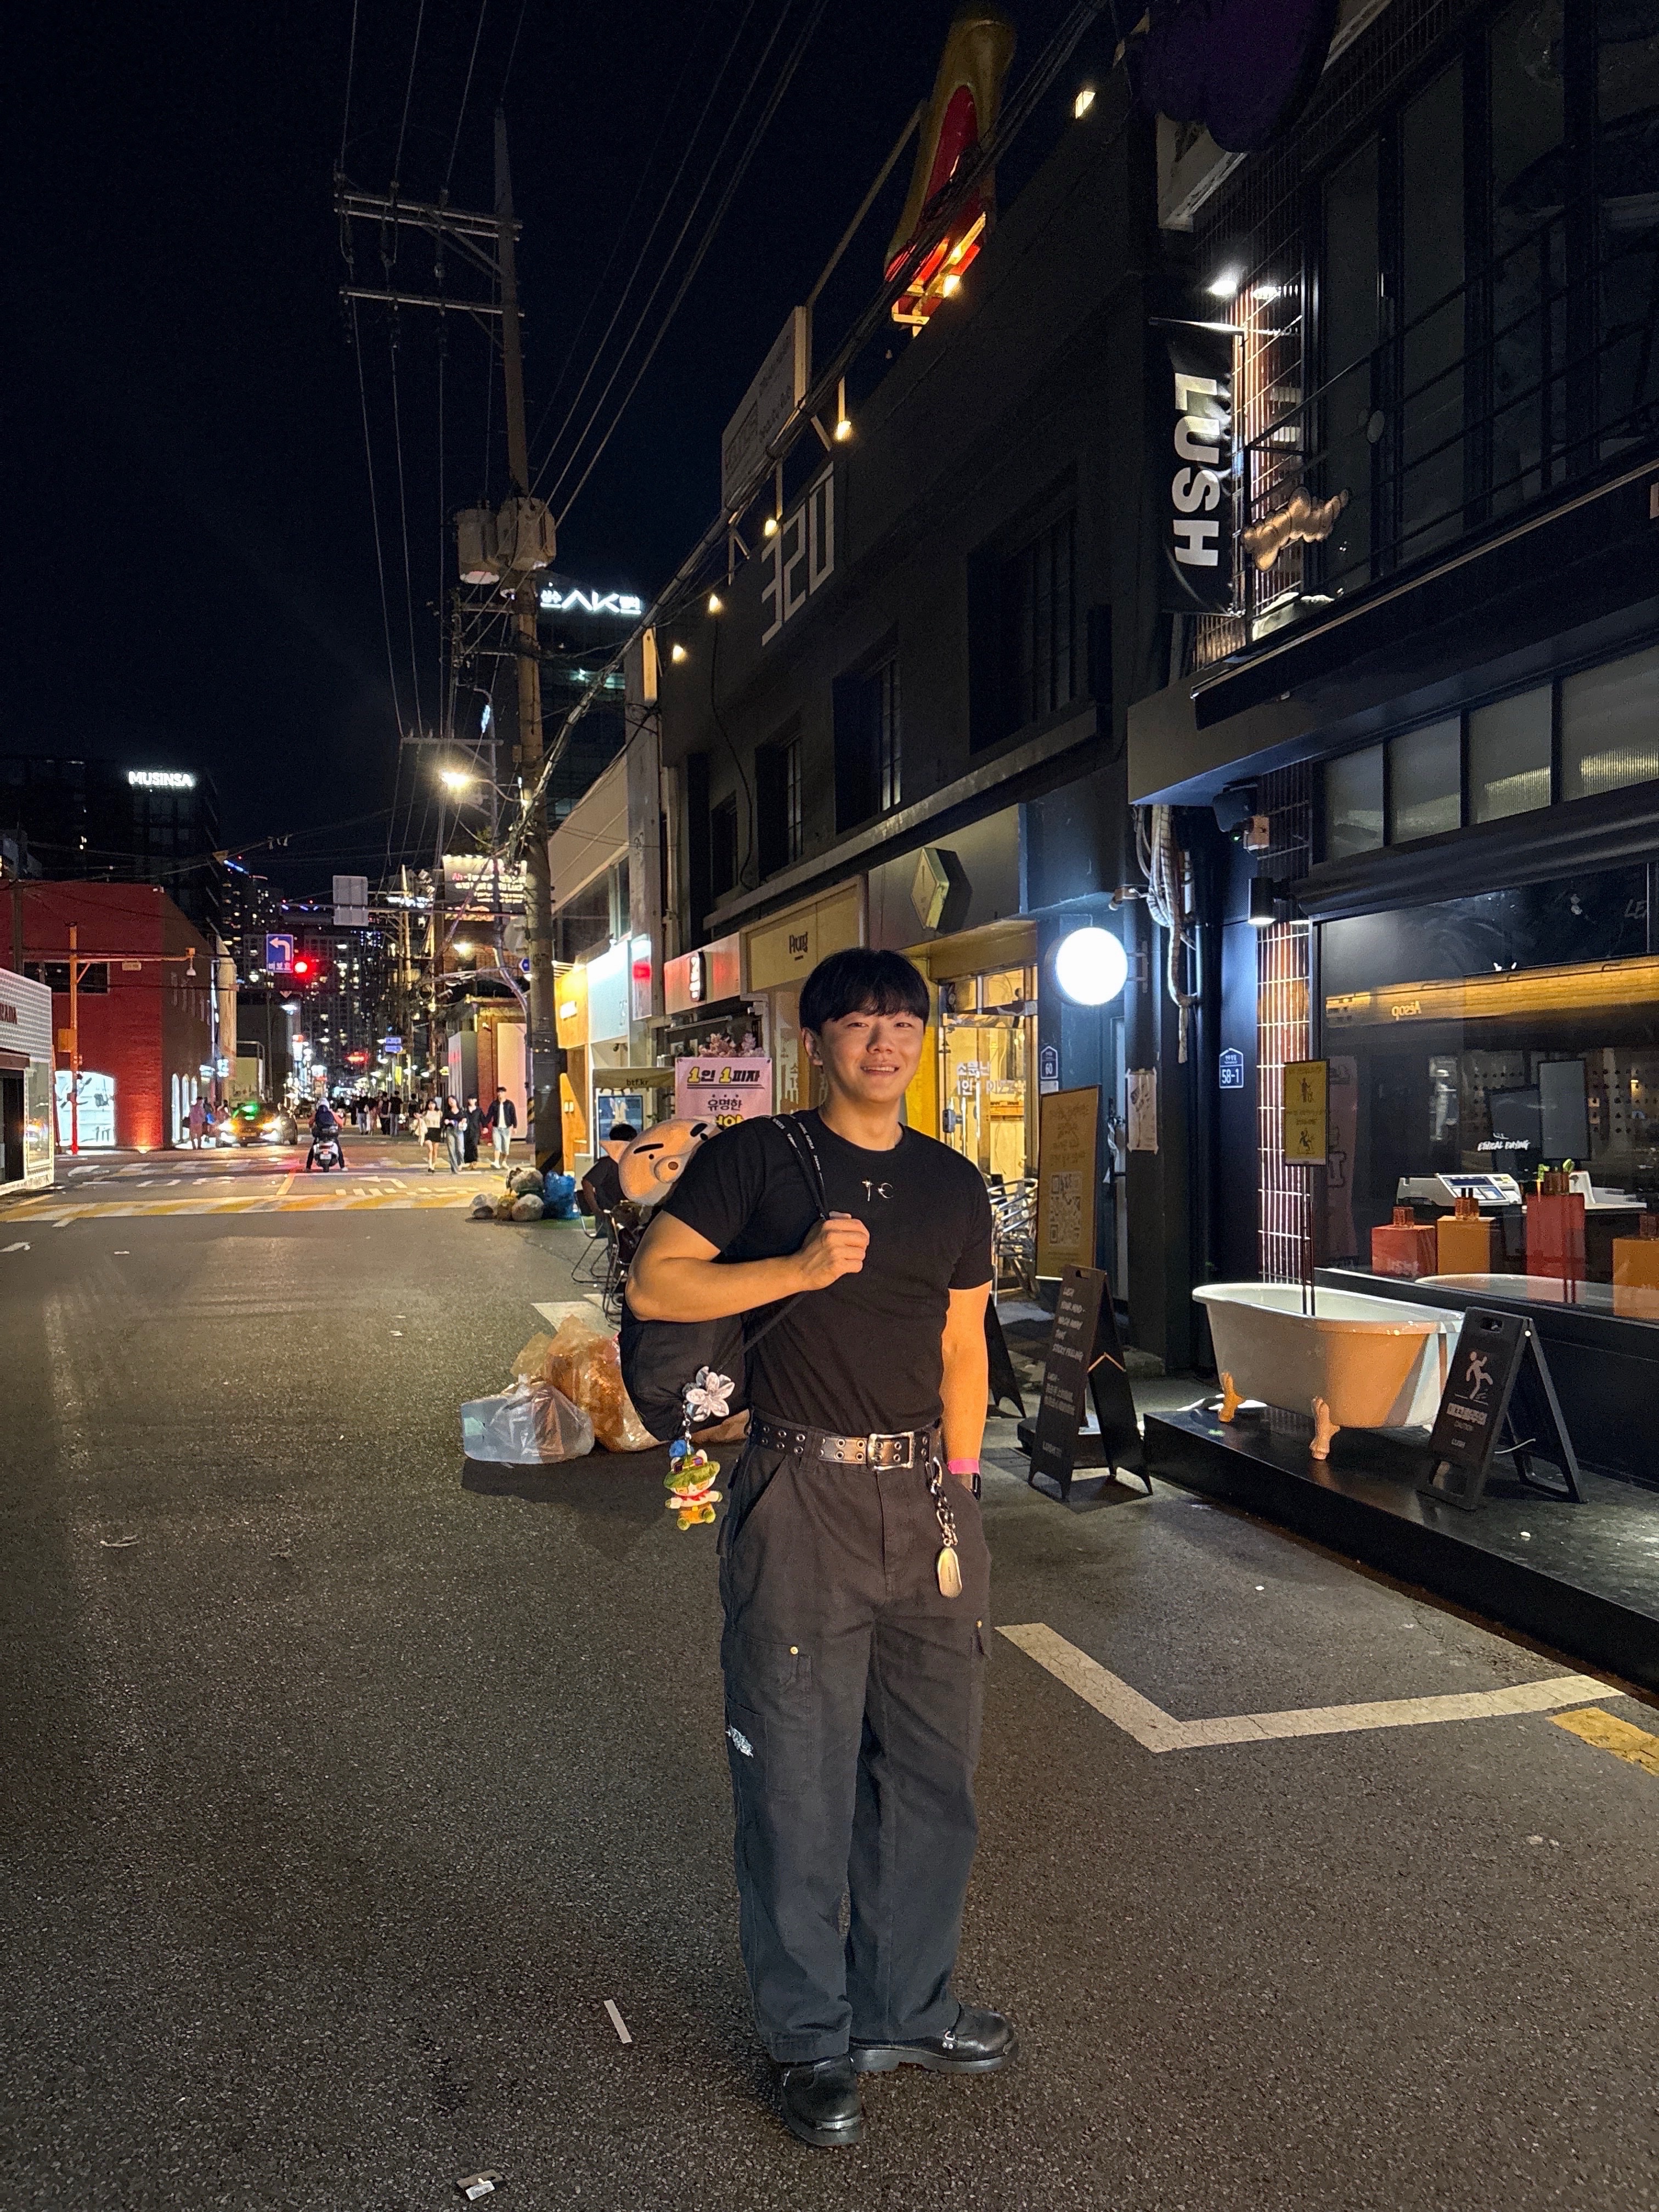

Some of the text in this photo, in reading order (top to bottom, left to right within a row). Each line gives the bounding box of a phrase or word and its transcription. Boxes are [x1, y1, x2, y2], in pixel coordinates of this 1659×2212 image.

[1172, 373, 1221, 566] LUSH
[128, 771, 193, 787] MUSINSA
[268, 961, 291, 970] 비보호
[687, 1066, 760, 1084] 1인 1피자
[1222, 1068, 1239, 1084] 58-1
[708, 1098, 743, 1111] 유명한
